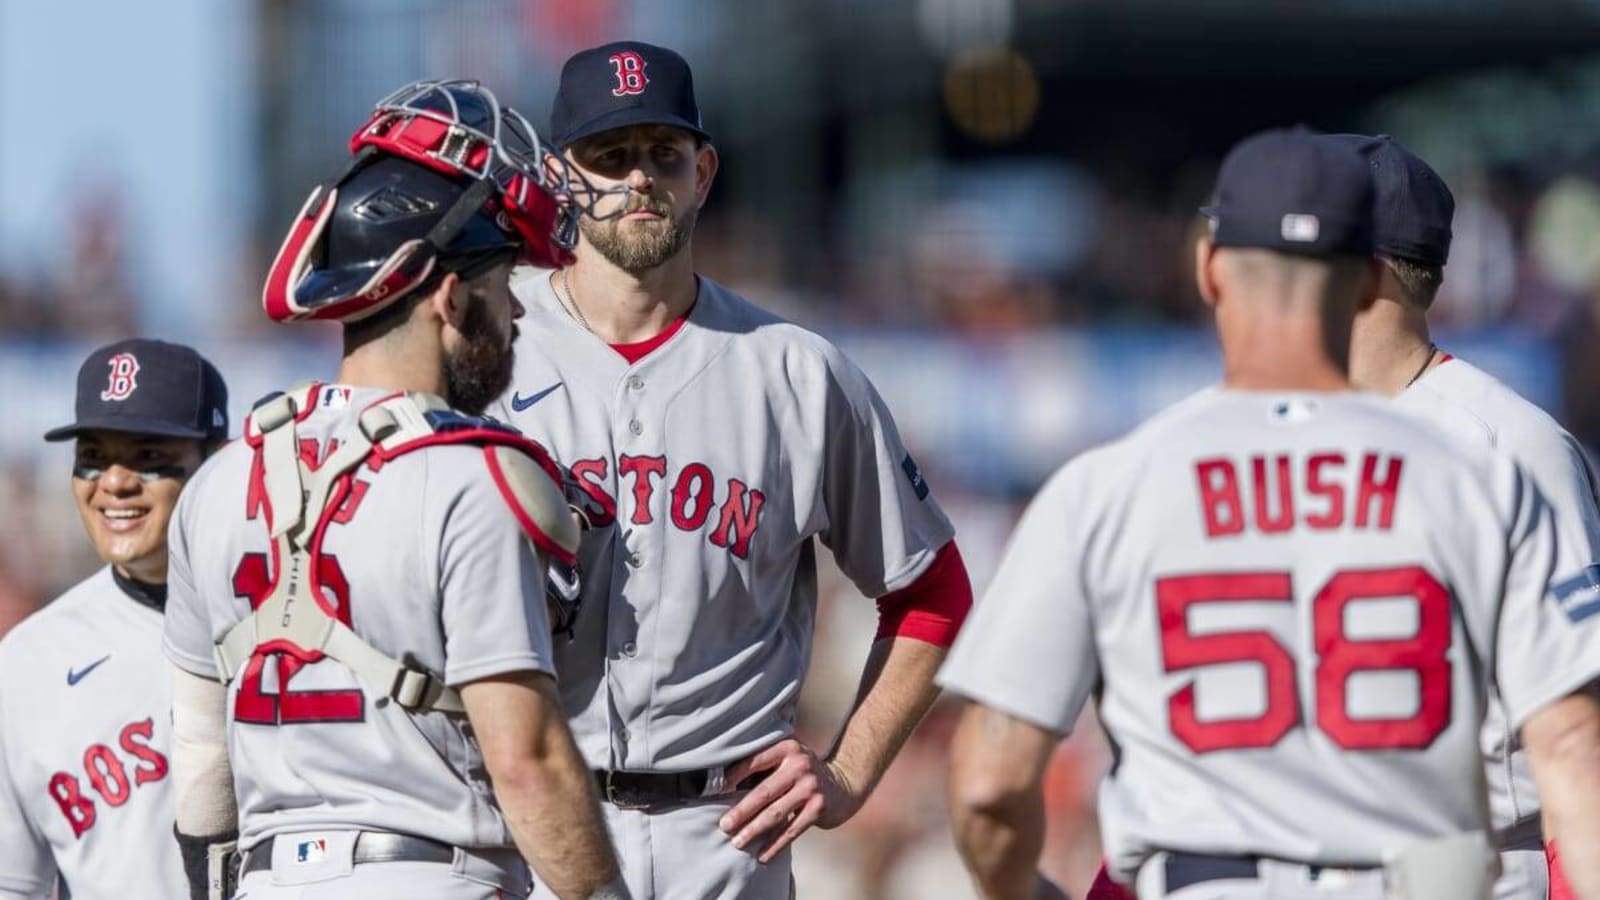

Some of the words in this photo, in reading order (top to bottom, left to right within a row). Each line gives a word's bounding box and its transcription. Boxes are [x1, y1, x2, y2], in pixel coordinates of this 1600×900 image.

[609, 52, 650, 96] B
[101, 352, 140, 401] B
[571, 453, 766, 560] STON
[1194, 451, 1404, 538] BUSH
[282, 557, 300, 628] HIELD
[1154, 565, 1453, 754] 58
[48, 717, 169, 840] BOS
